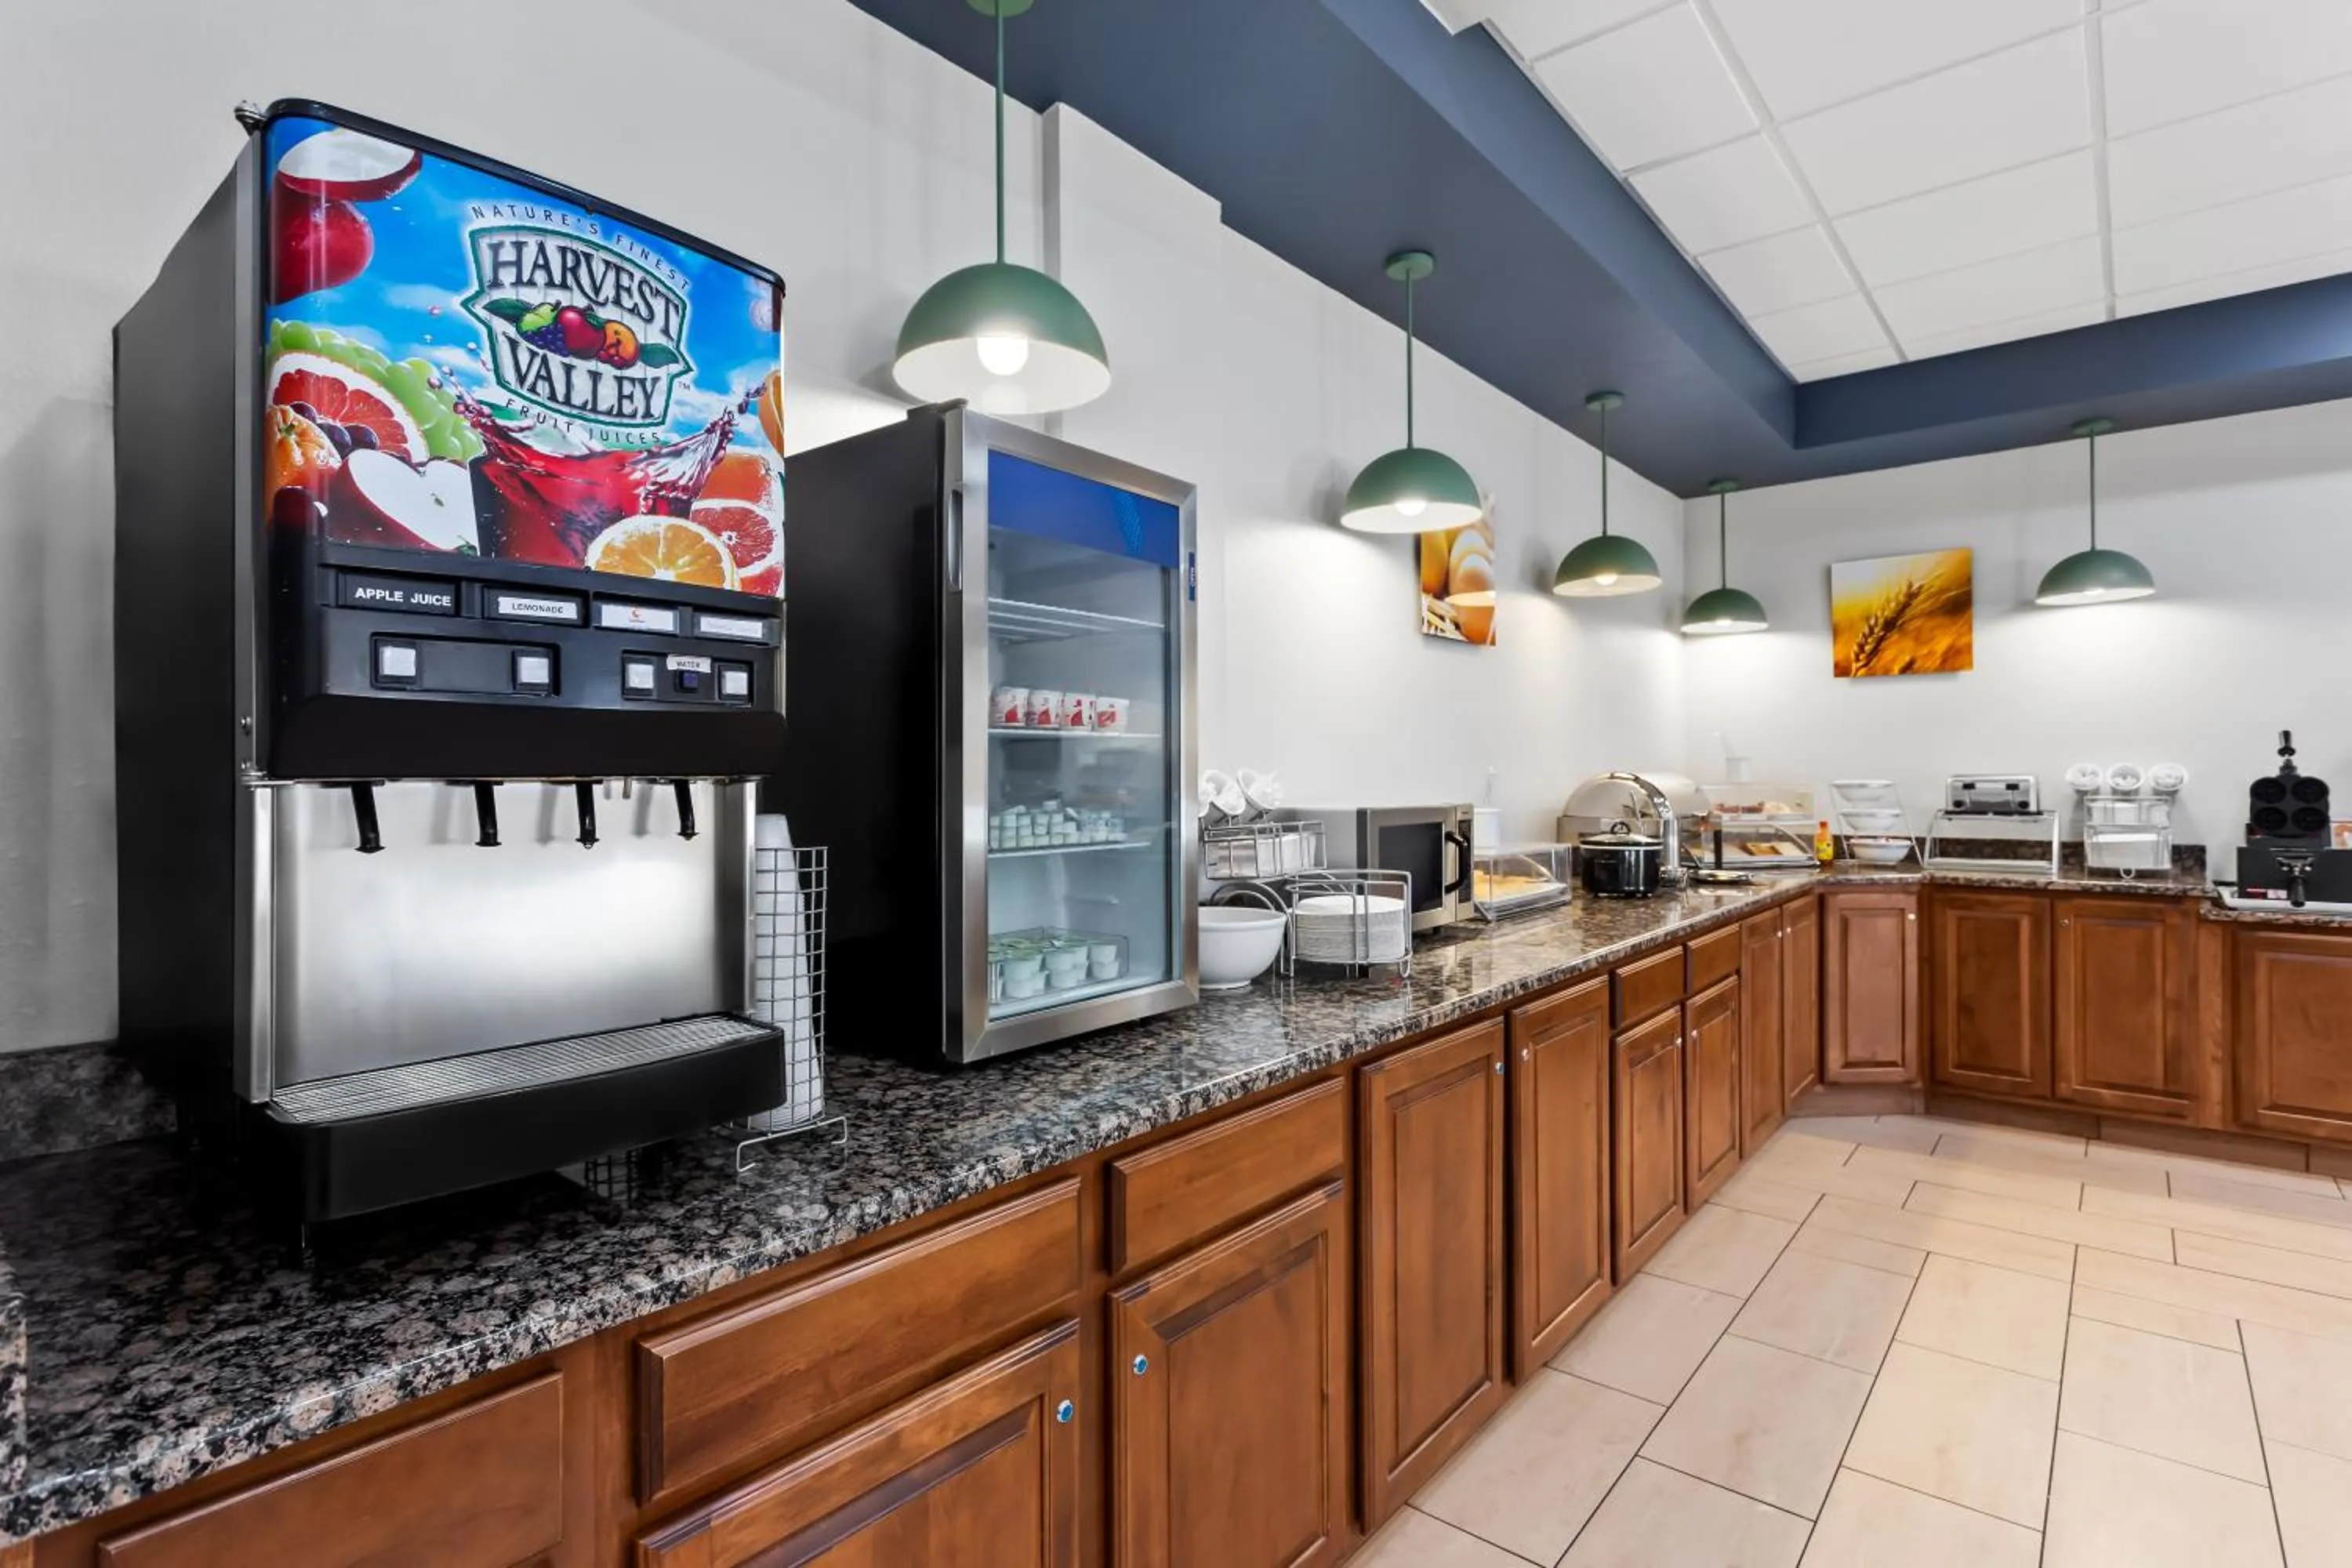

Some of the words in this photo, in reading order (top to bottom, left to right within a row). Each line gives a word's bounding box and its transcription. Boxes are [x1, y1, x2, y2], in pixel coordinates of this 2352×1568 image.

[472, 205, 598, 234] NATURE'S
[615, 234, 690, 290] FINEST
[486, 239, 680, 341] HARVEST
[502, 331, 662, 419] VALLEY
[506, 398, 574, 433] FRUIT
[589, 427, 661, 444] JUICES
[354, 586, 404, 602] APPLE
[410, 593, 452, 607] JUICE
[512, 603, 564, 614] LEMONADE
